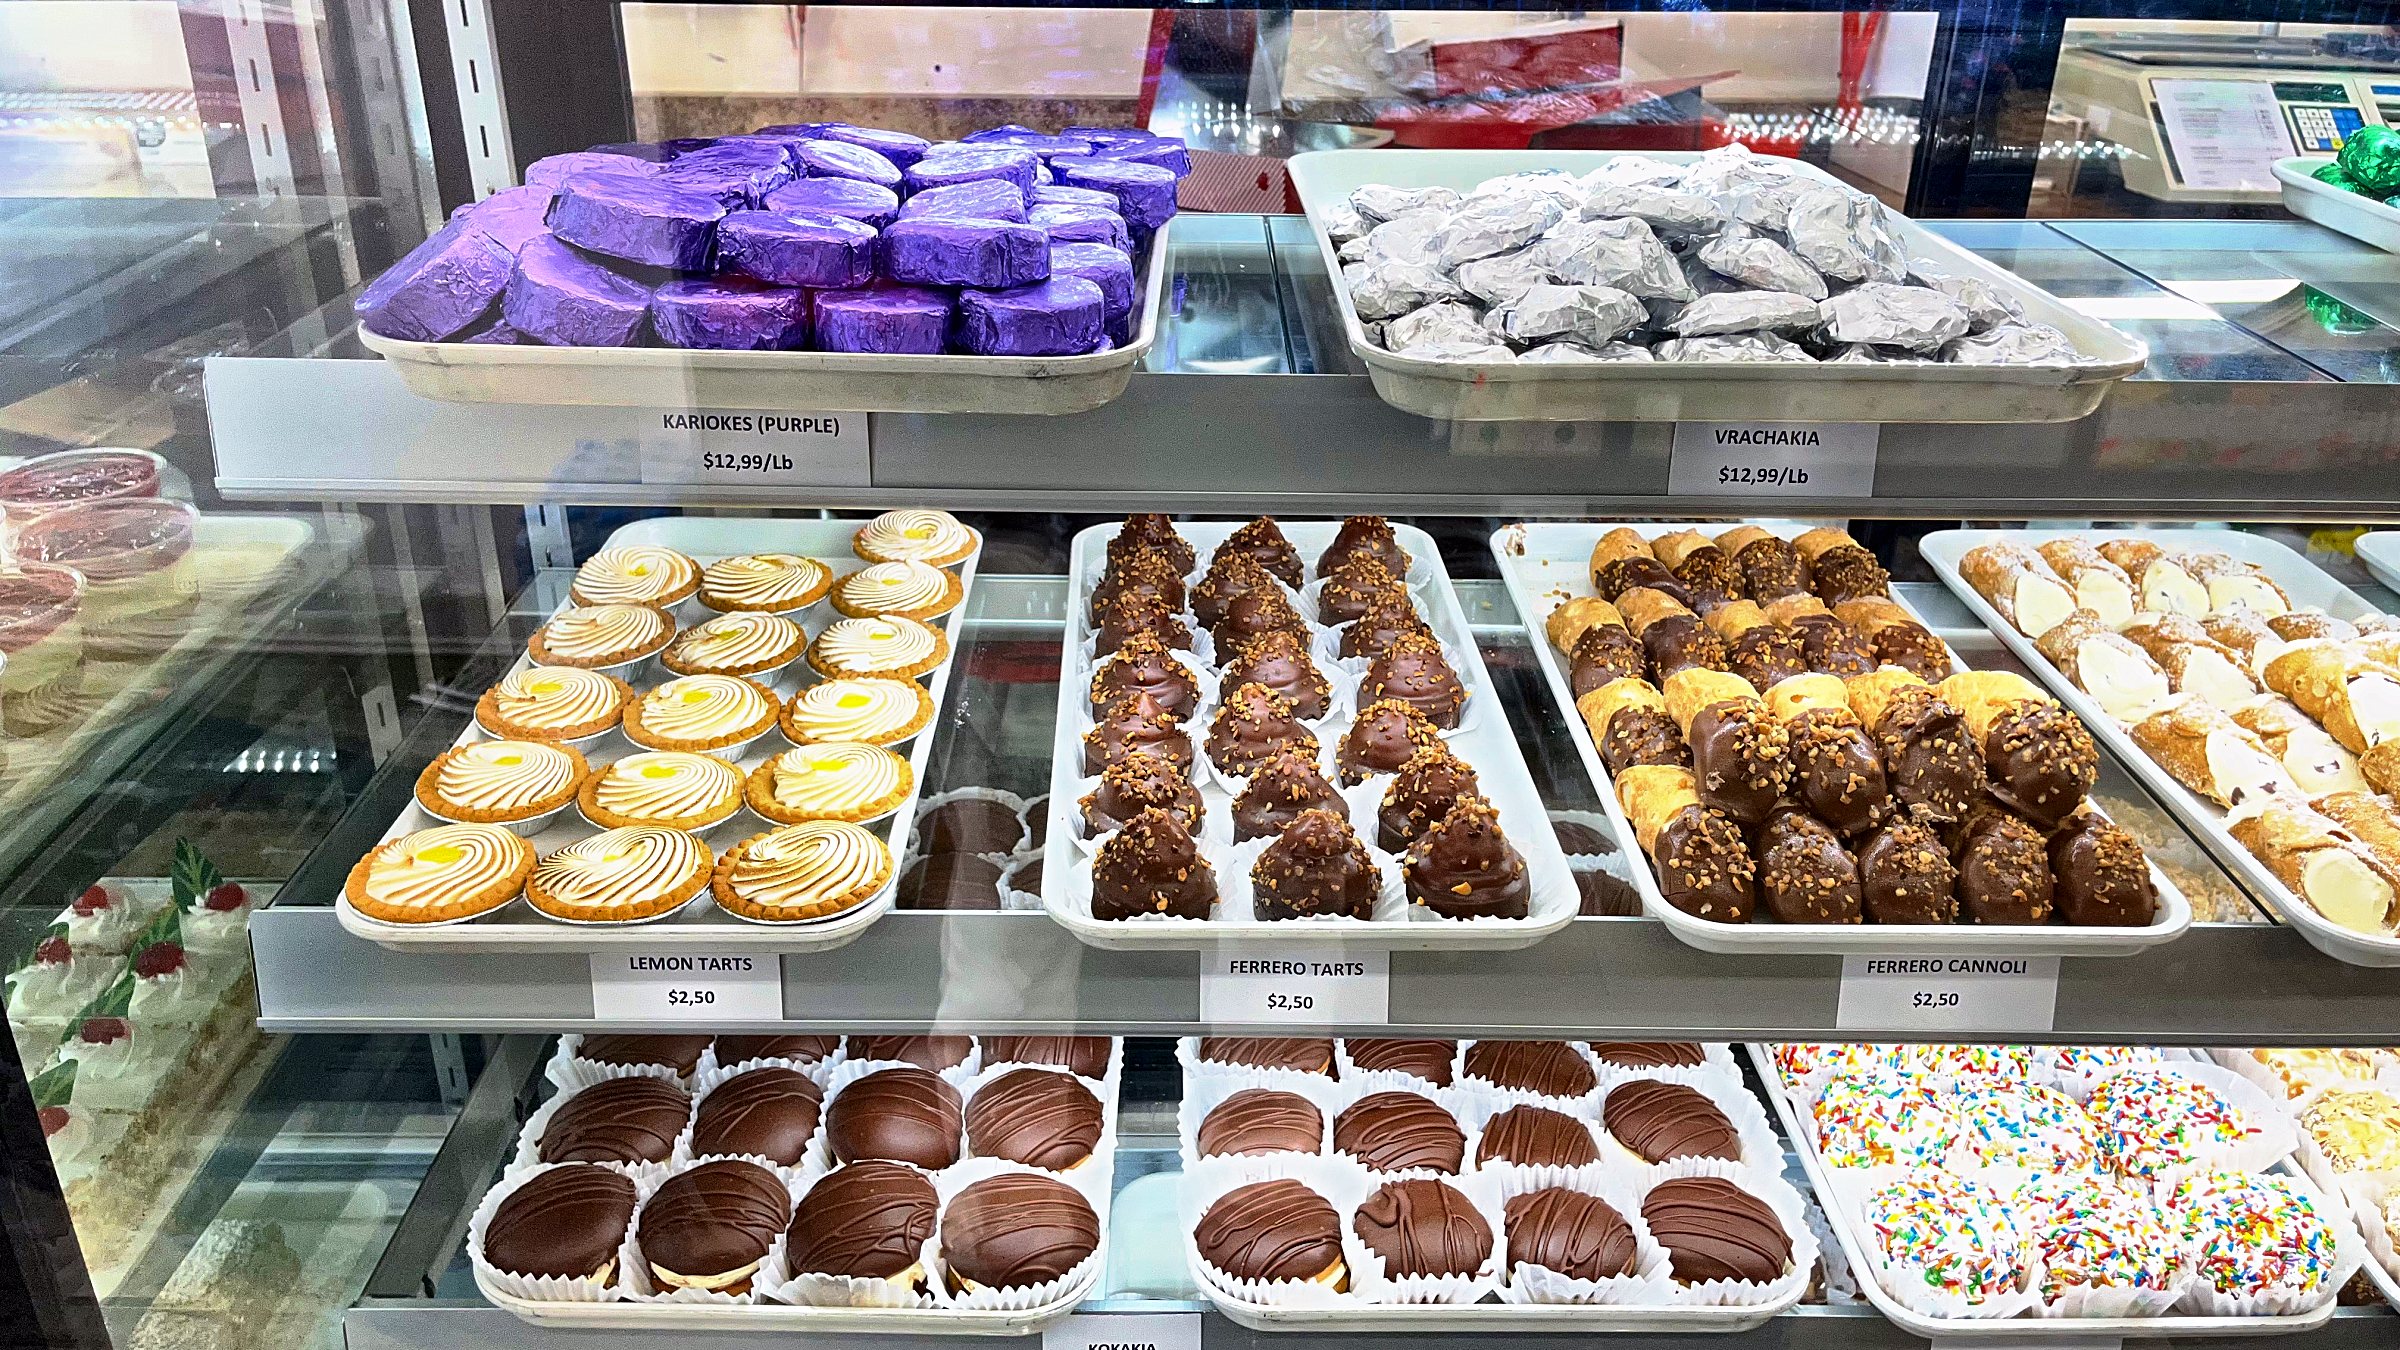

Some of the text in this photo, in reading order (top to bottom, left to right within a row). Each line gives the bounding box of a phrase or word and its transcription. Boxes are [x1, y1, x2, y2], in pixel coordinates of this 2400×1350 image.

[662, 414, 840, 437] KARIOKES (PURPLE)
[1715, 429, 1820, 446] VRACHAKIA
[703, 451, 793, 472] $12,99/Lb
[1718, 465, 1809, 486] $12,99/Lb
[629, 956, 753, 971] LEMON TARTS
[1230, 960, 1364, 976] FERRERO TARTS
[1867, 959, 2027, 974] FERRERO CANNOLI
[668, 989, 715, 1006] $2,50
[1267, 993, 1313, 1011] $2,50
[1912, 991, 1959, 1008] $2,50
